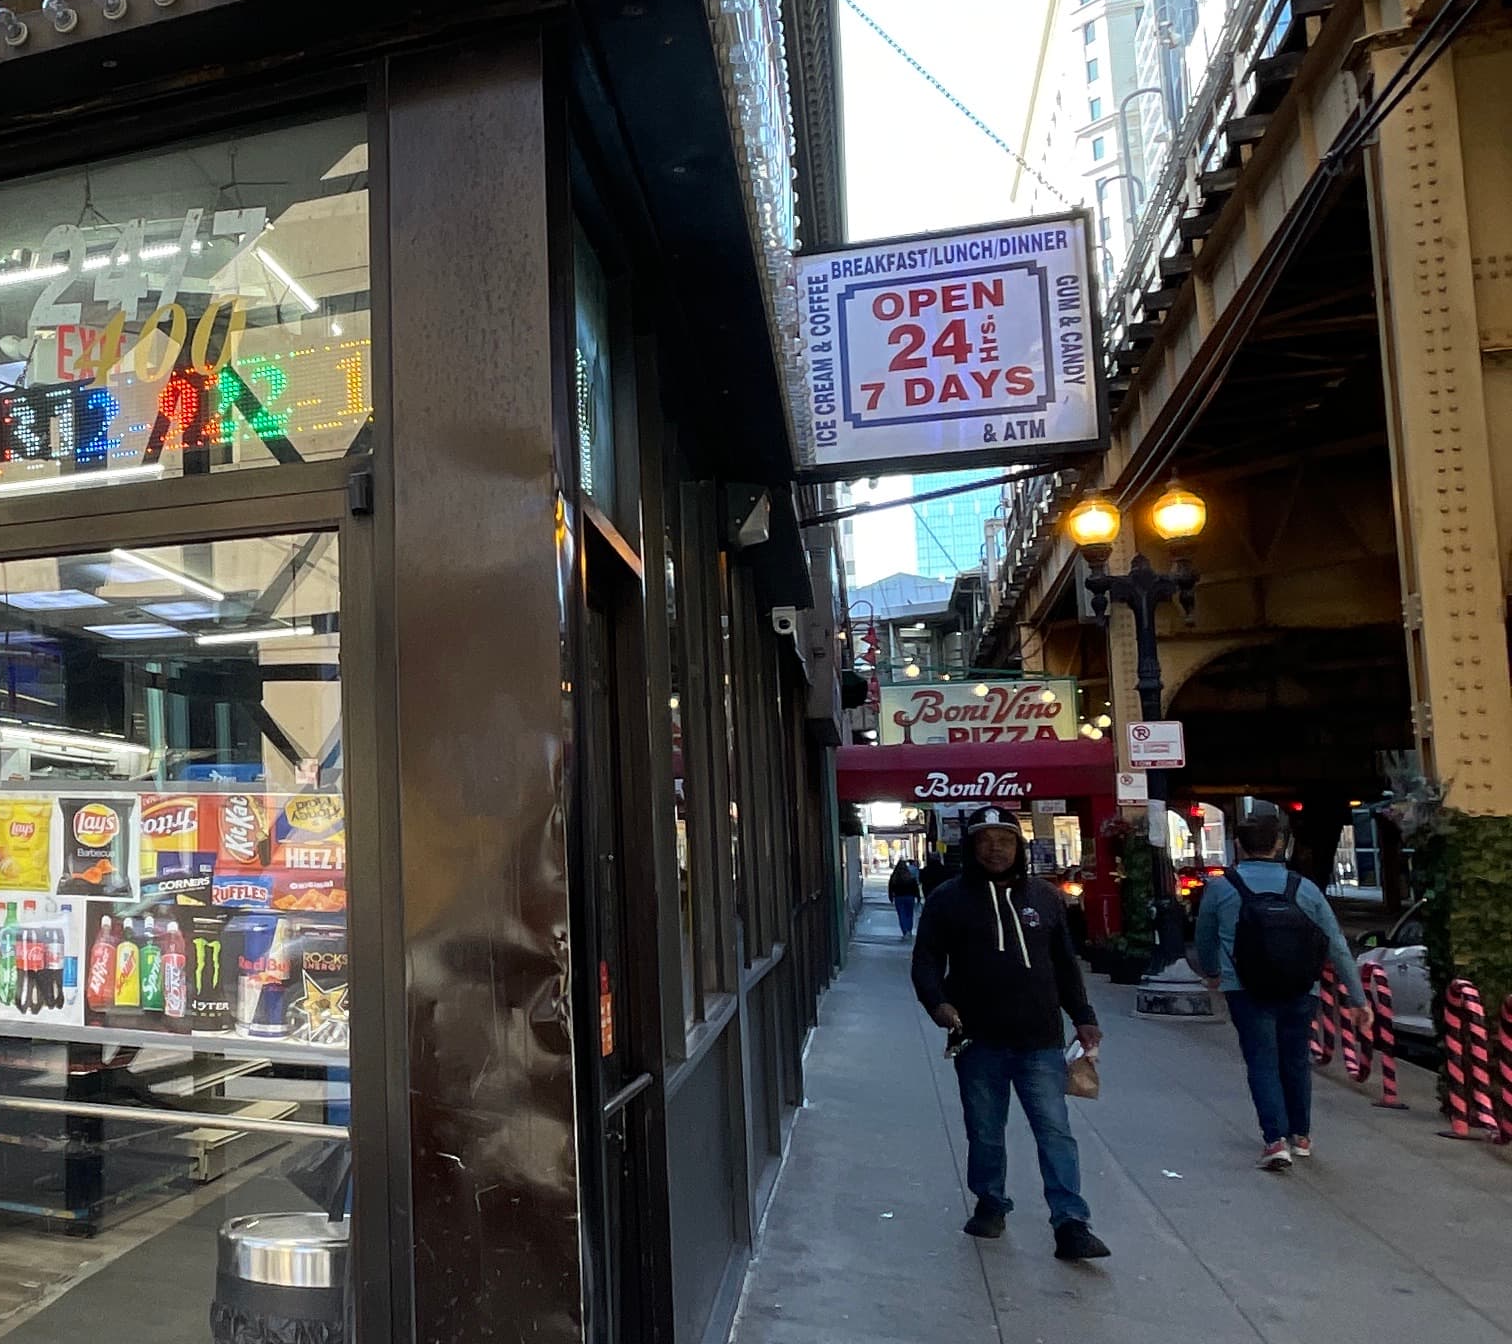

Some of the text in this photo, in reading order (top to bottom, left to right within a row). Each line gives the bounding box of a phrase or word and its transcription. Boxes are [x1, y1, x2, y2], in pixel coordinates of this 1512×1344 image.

[831, 229, 1067, 280] BREAKFAST/LUNCH/DINNER
[872, 279, 1004, 321] OPEN
[888, 315, 999, 372] 24 Hrs.
[1057, 275, 1086, 386] GUM & CANDY
[808, 273, 837, 448] ICE CREAM & COFFEE
[861, 366, 1035, 410] 7 DAYS
[983, 419, 1046, 442] & ATM
[948, 725, 1059, 743] PIZZA
[158, 876, 210, 891] CORNERS
[212, 885, 267, 904] RUFFLES
